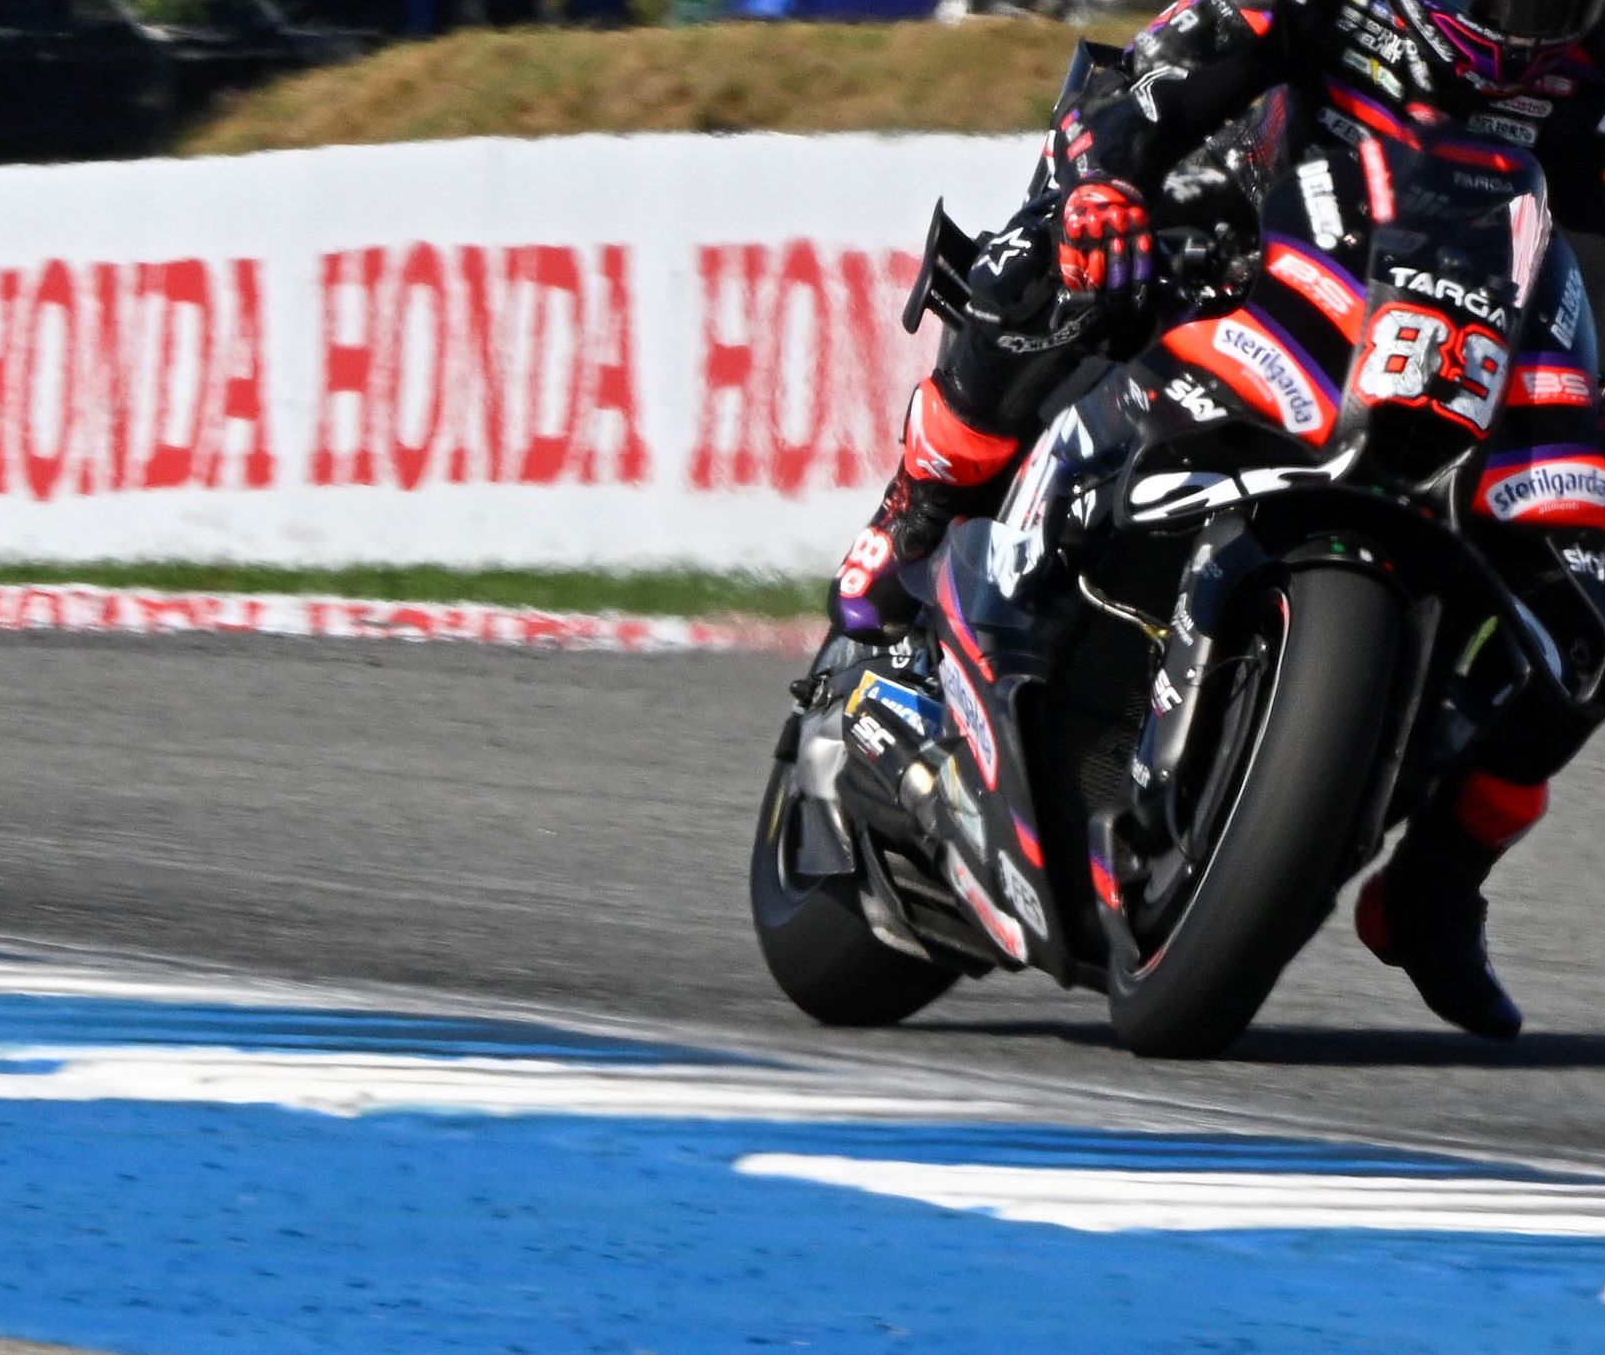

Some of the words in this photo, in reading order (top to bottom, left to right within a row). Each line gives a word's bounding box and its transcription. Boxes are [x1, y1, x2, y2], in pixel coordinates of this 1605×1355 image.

[1389, 267, 1508, 333] TARGA
[308, 240, 653, 491] HONDA
[688, 237, 924, 500] HON
[1164, 372, 1228, 422] sky
[1222, 327, 1314, 424] sterilgarda
[1352, 301, 1510, 439] 89
[1562, 543, 1605, 582] sky
